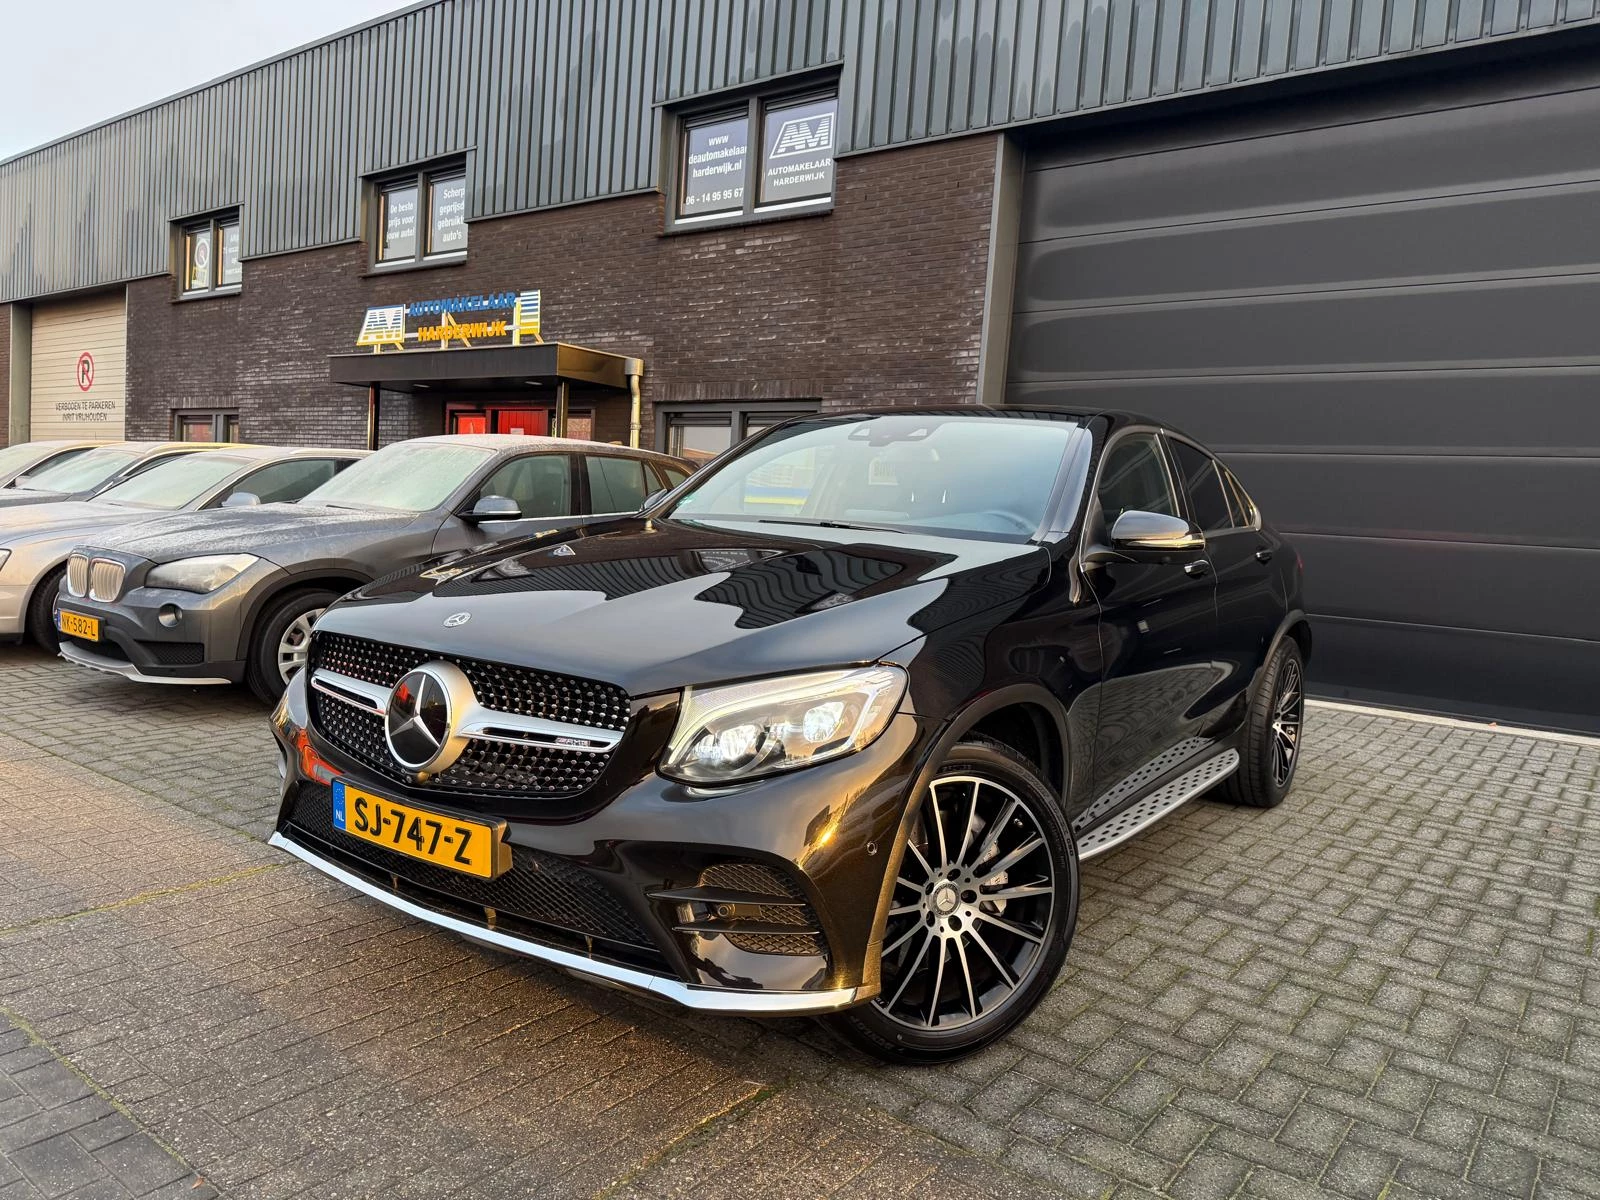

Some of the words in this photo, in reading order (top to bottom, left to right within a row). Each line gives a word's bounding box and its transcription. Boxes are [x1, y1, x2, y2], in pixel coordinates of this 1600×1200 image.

[708, 135, 729, 147] www
[777, 117, 830, 153] AM
[692, 160, 742, 178] harderwijk.nl
[767, 158, 831, 177] AUTOMAKELAAR
[773, 172, 825, 187] HARDERWIJK
[443, 188, 465, 199] Scherp
[686, 195, 695, 205] 06
[702, 193, 711, 203] 14
[712, 191, 721, 201] 95
[723, 189, 732, 200] 95
[734, 188, 744, 198] 67
[401, 215, 415, 225] voor
[438, 216, 465, 230] gebruikt
[442, 230, 462, 242] auto's
[408, 291, 516, 317] AUTOMAKELAAR
[418, 321, 507, 342] HARDERWIJK
[56, 402, 80, 411] VERBODEN
[82, 402, 87, 410] TE
[88, 401, 116, 410] PARKEREN
[335, 809, 345, 822] NL
[354, 797, 473, 865] SJ-747-Z
